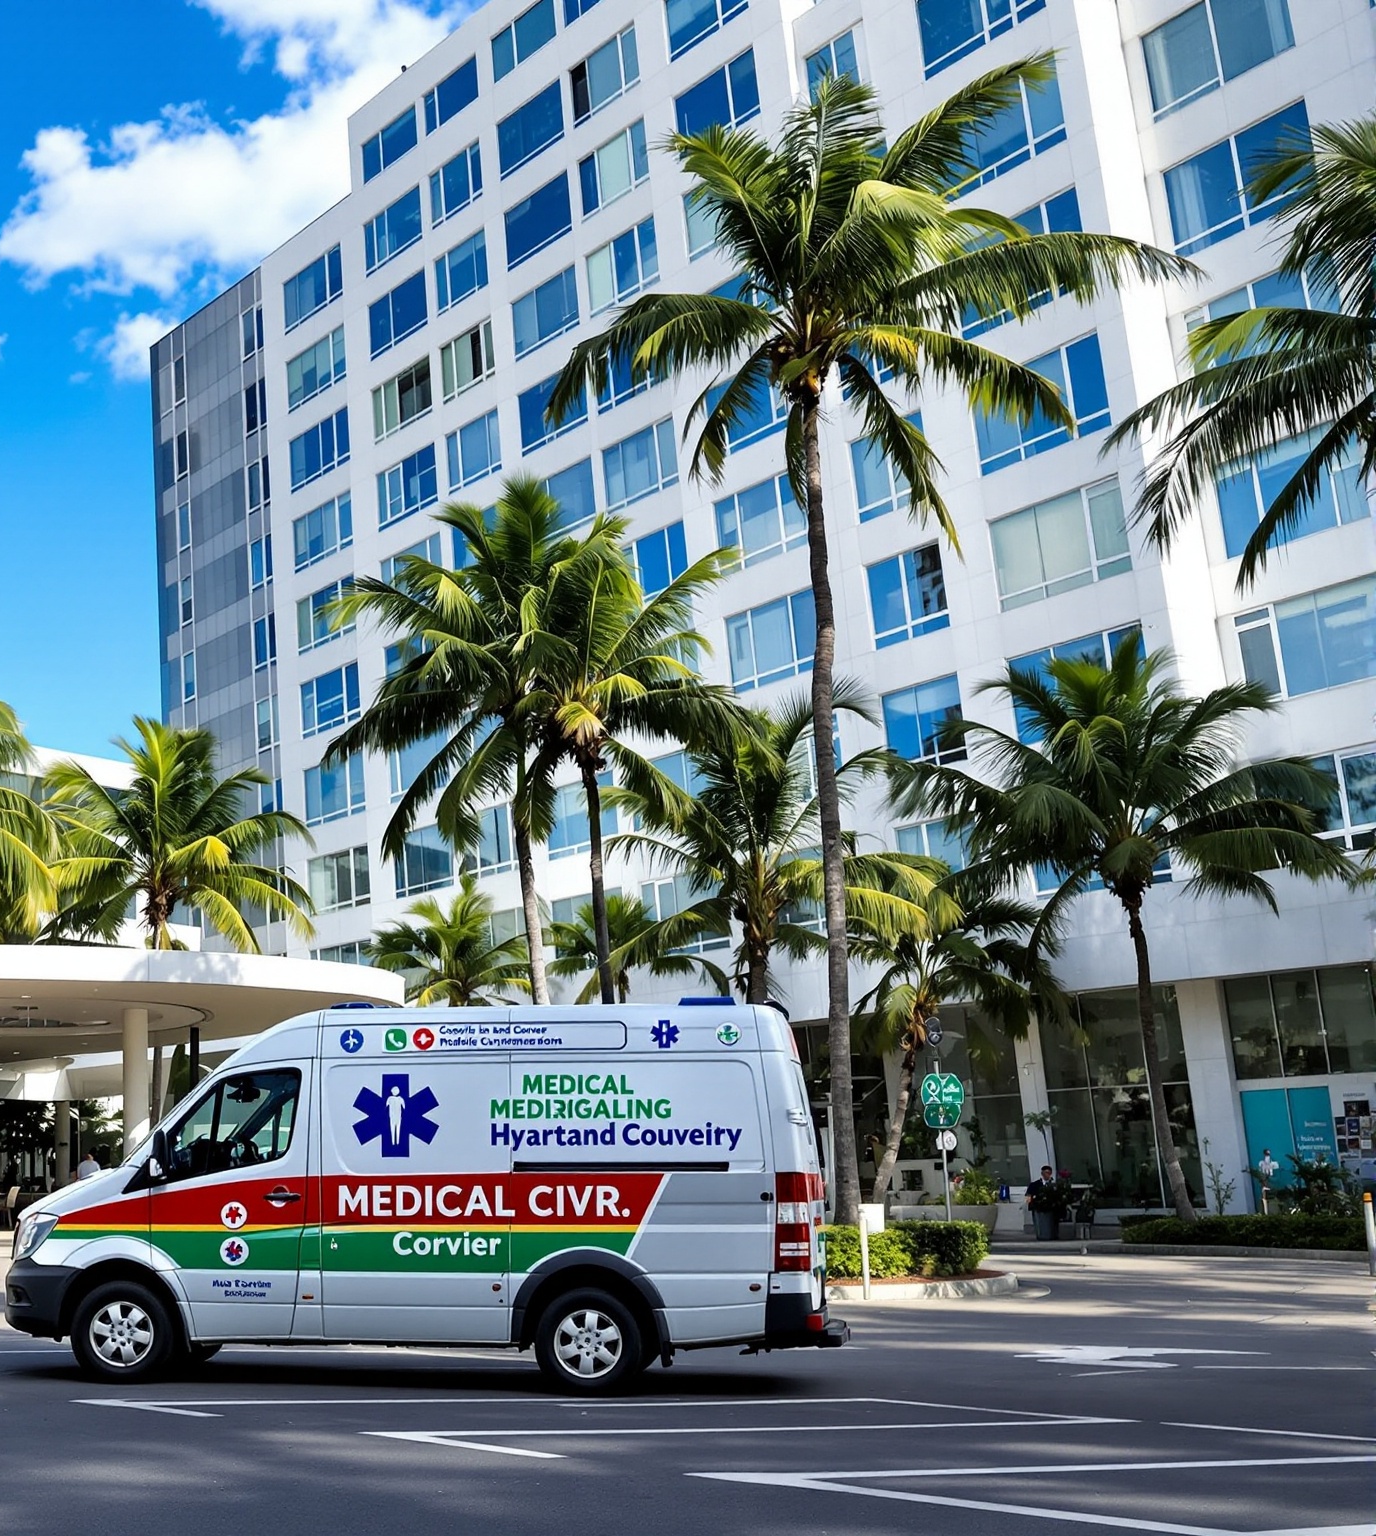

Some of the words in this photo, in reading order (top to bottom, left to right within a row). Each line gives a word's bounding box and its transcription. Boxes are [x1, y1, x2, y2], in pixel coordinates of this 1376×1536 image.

[522, 1074, 634, 1095] MEDICAL
[490, 1122, 615, 1151] Hyartand
[338, 1185, 516, 1217] MEDICAL
[528, 1185, 630, 1218] CIVR.
[392, 1231, 501, 1256] Corvier
